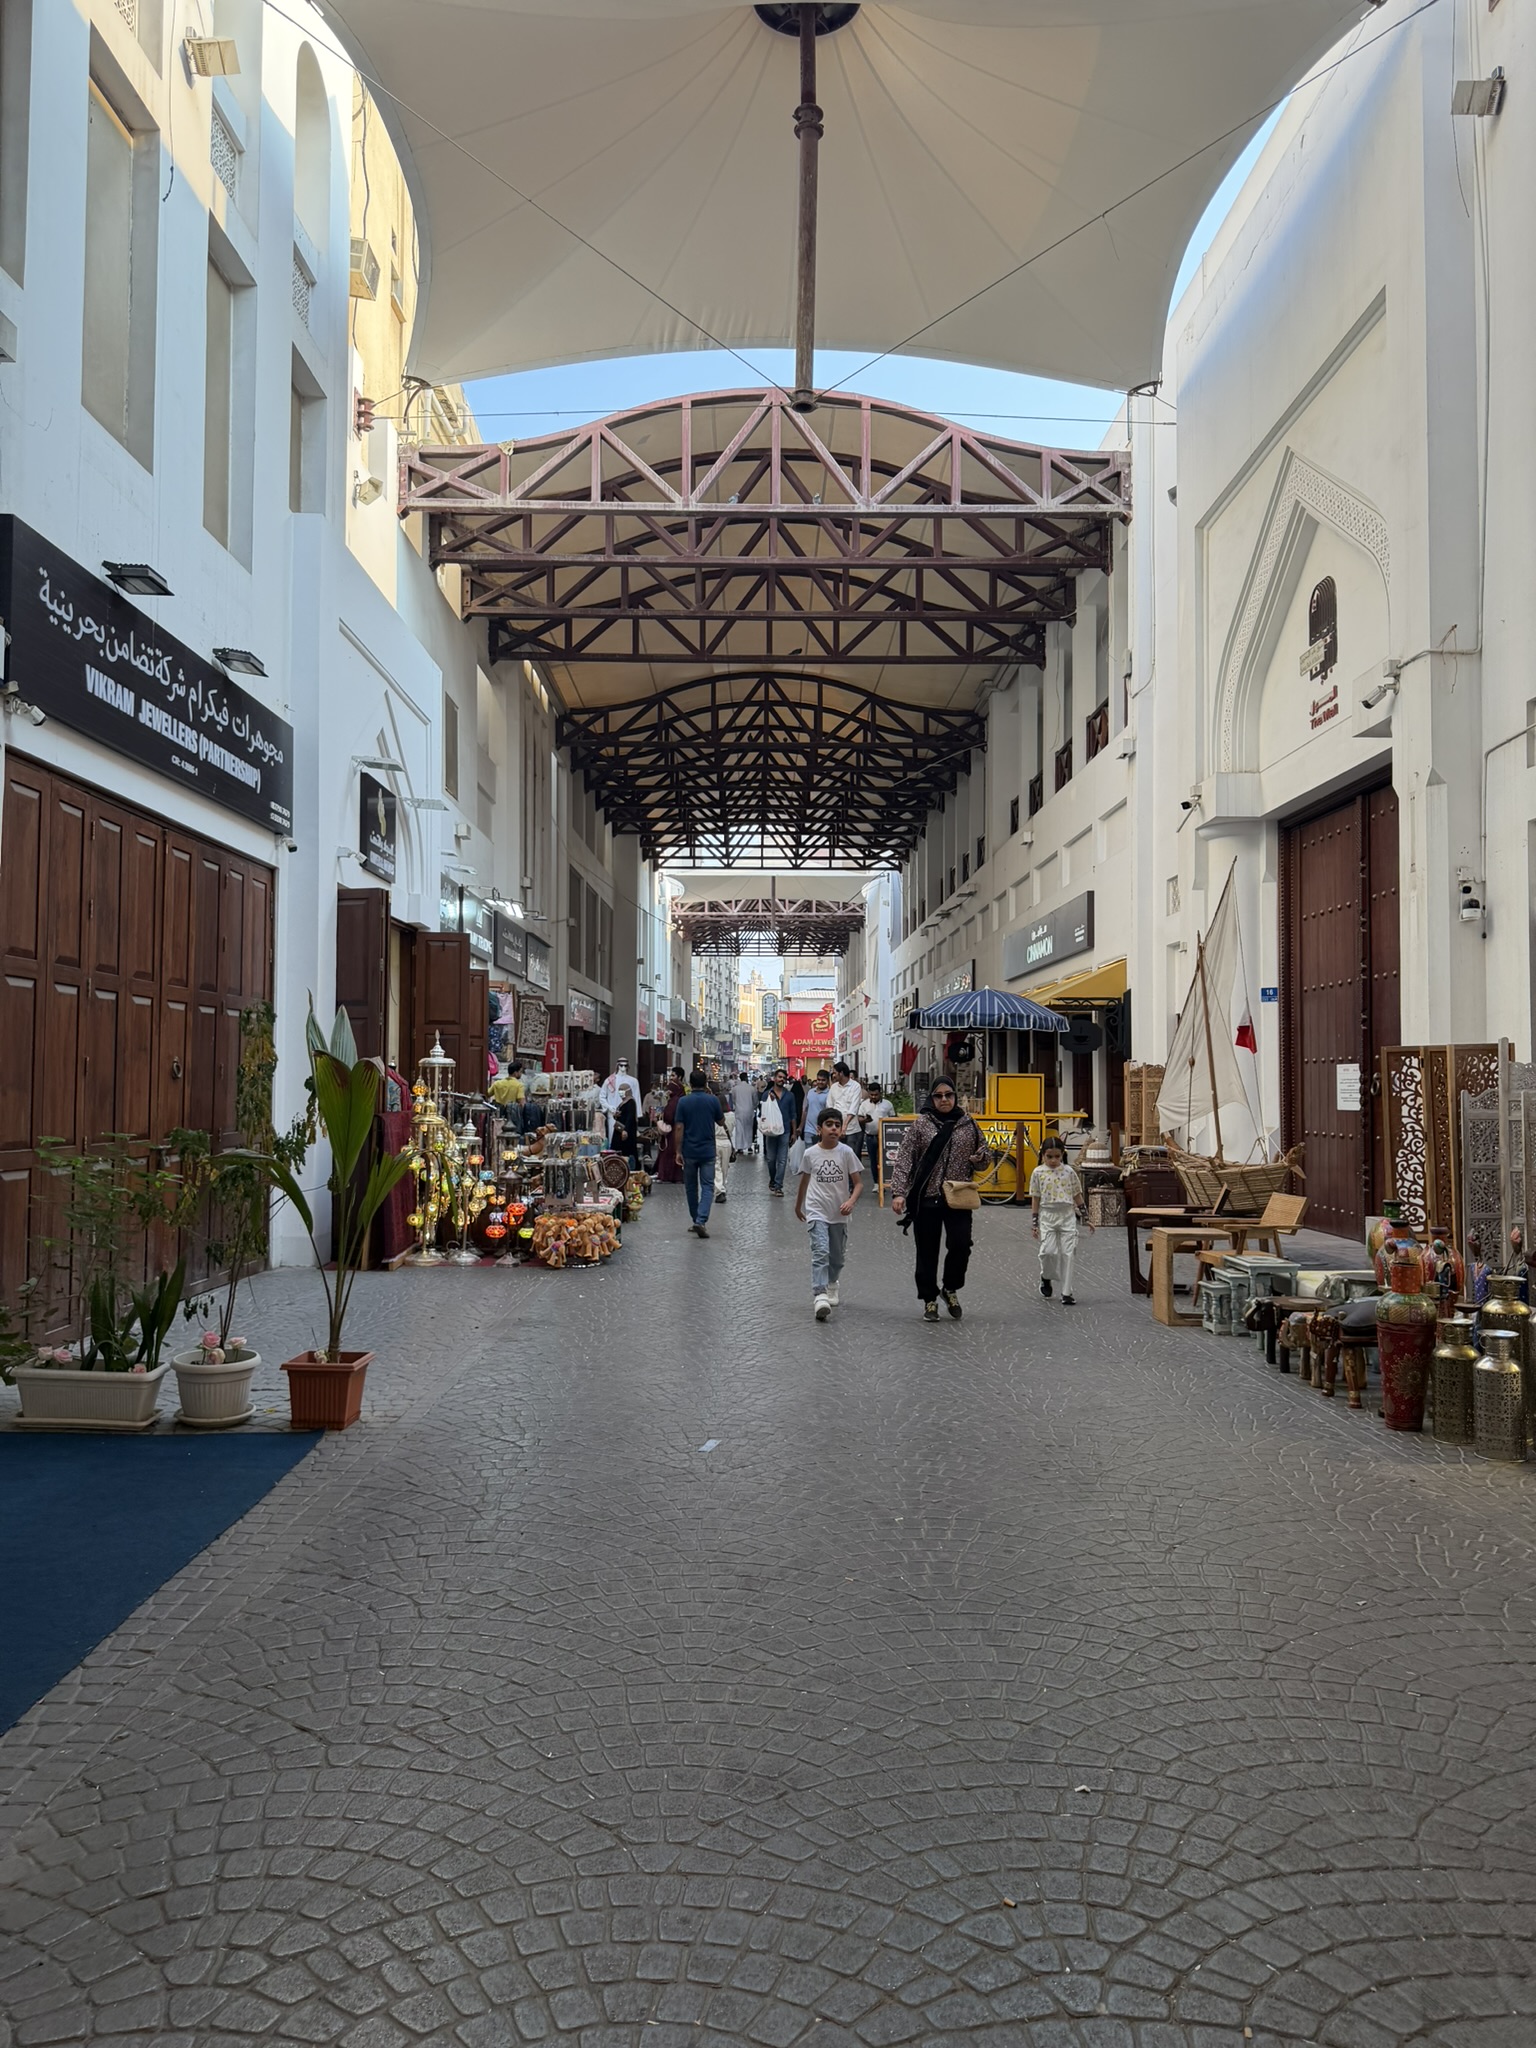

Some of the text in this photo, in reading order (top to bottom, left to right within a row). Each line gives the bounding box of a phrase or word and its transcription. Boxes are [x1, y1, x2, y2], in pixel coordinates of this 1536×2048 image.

[39, 566, 283, 767] مجوهرات فيكرام شركة تضامن بحرينية
[85, 663, 261, 794] VIKRAM JEWELLERS (PARTNERSHIP)
[1310, 703, 1339, 730] The Mall
[1027, 935, 1052, 964] CINNAMON
[817, 1175, 843, 1183] Kappa
